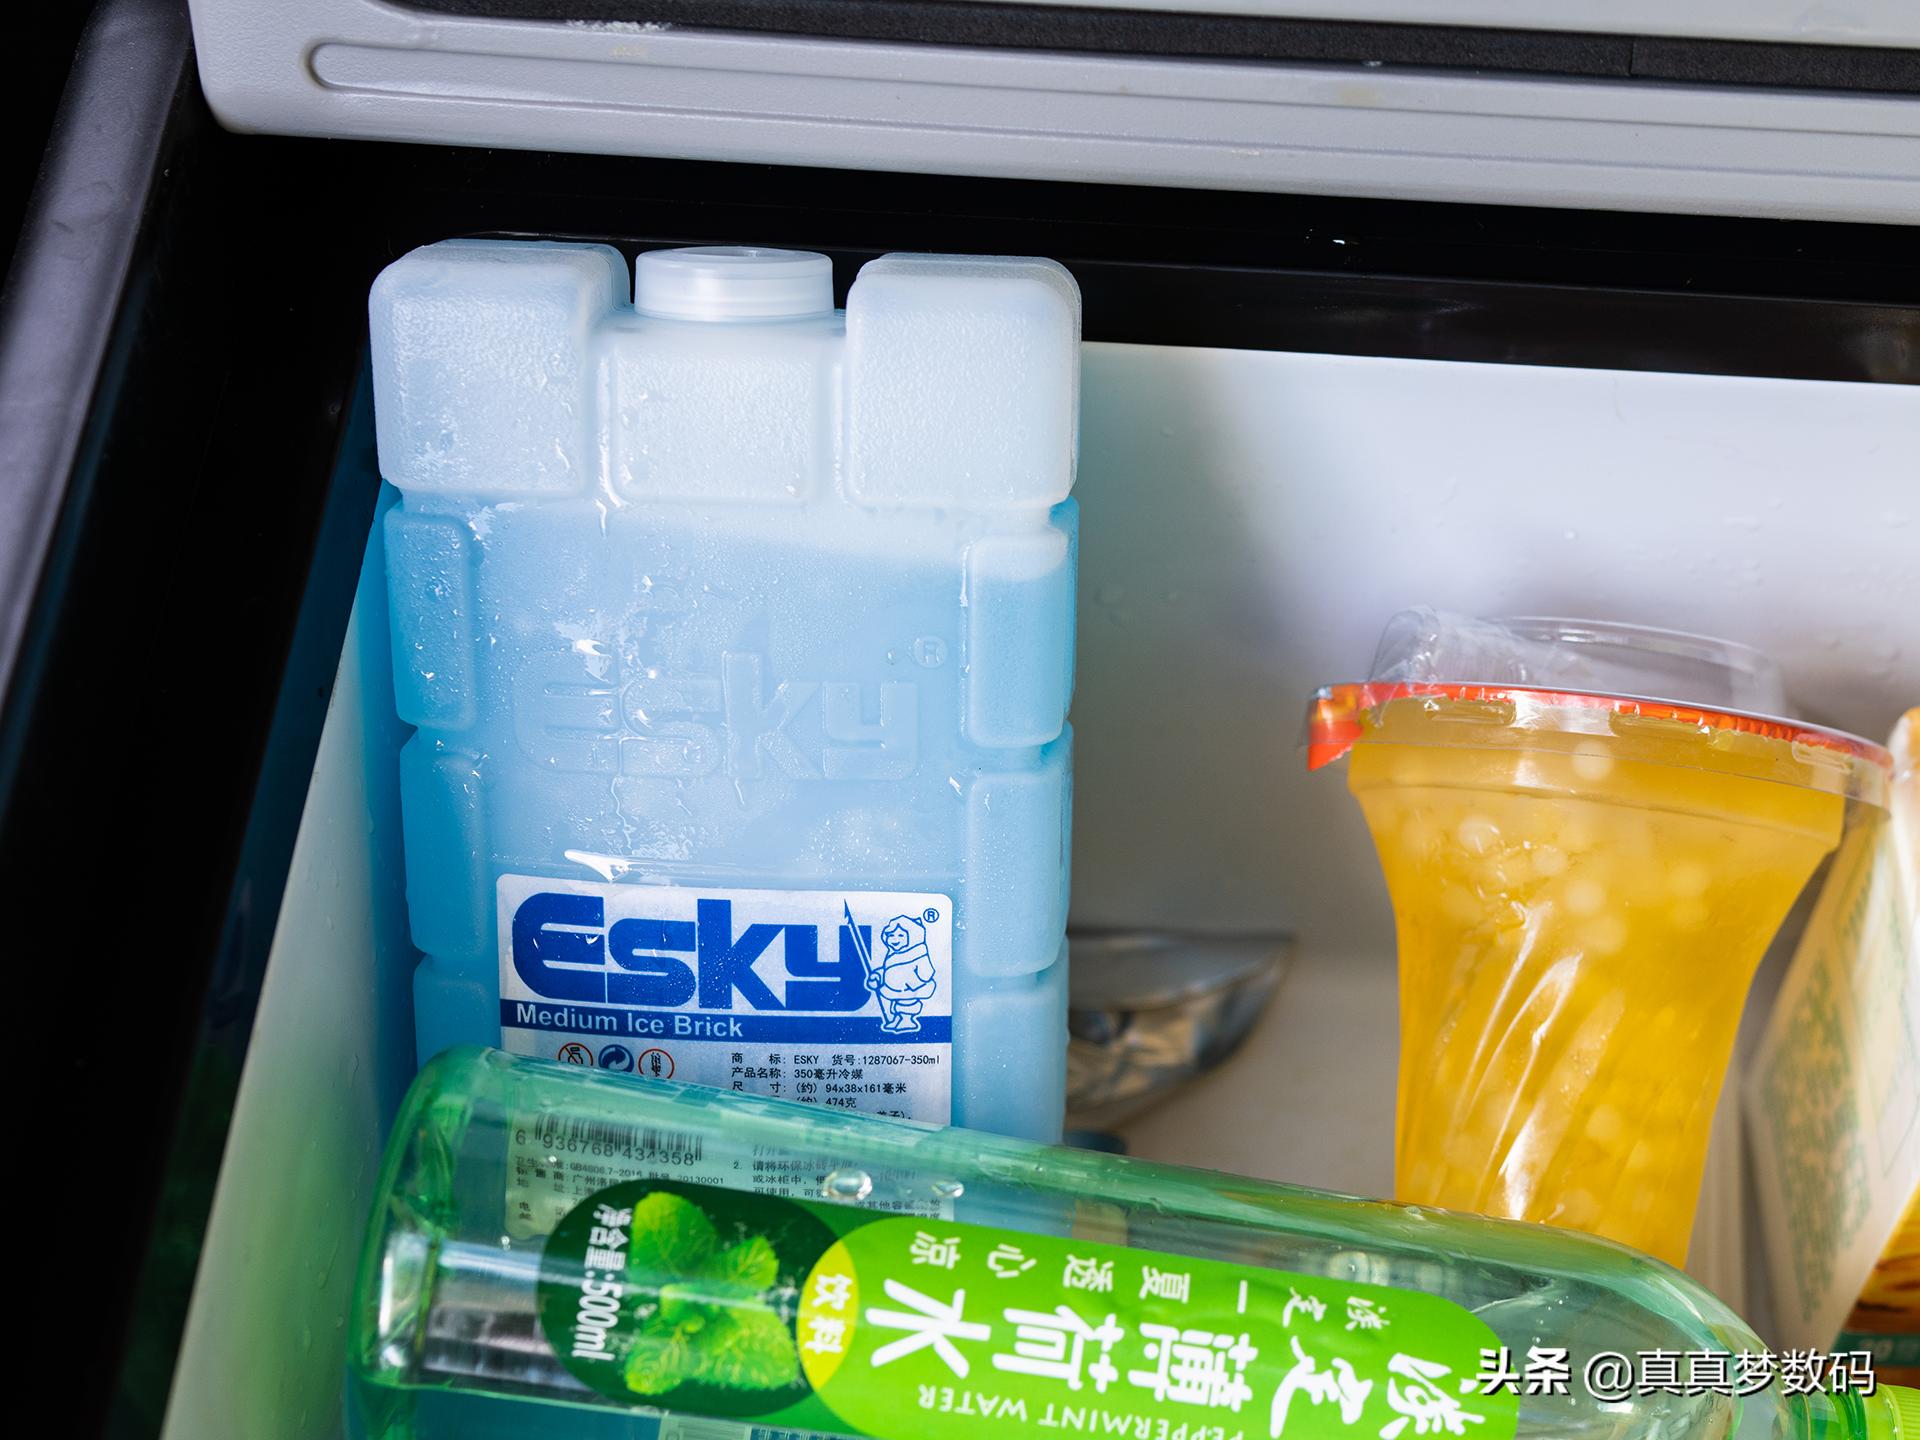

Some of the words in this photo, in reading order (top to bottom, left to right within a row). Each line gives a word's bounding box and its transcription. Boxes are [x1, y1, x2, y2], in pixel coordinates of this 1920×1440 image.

[515, 1003, 618, 1034] Medium
[626, 1012, 664, 1035] Ice
[674, 1014, 743, 1038] Brick
[731, 1067, 786, 1078] 产品名称:
[794, 1069, 863, 1080] 350毫升冷媒
[794, 1055, 819, 1064] ESKY
[825, 1083, 906, 1094] 94x38x161毫米
[515, 1129, 526, 1145] 6
[543, 1133, 615, 1158] 936768
[571, 1202, 633, 1362] 净含量:500ml
[800, 1272, 854, 1356] 饮料
[918, 1383, 1028, 1422] WATER
